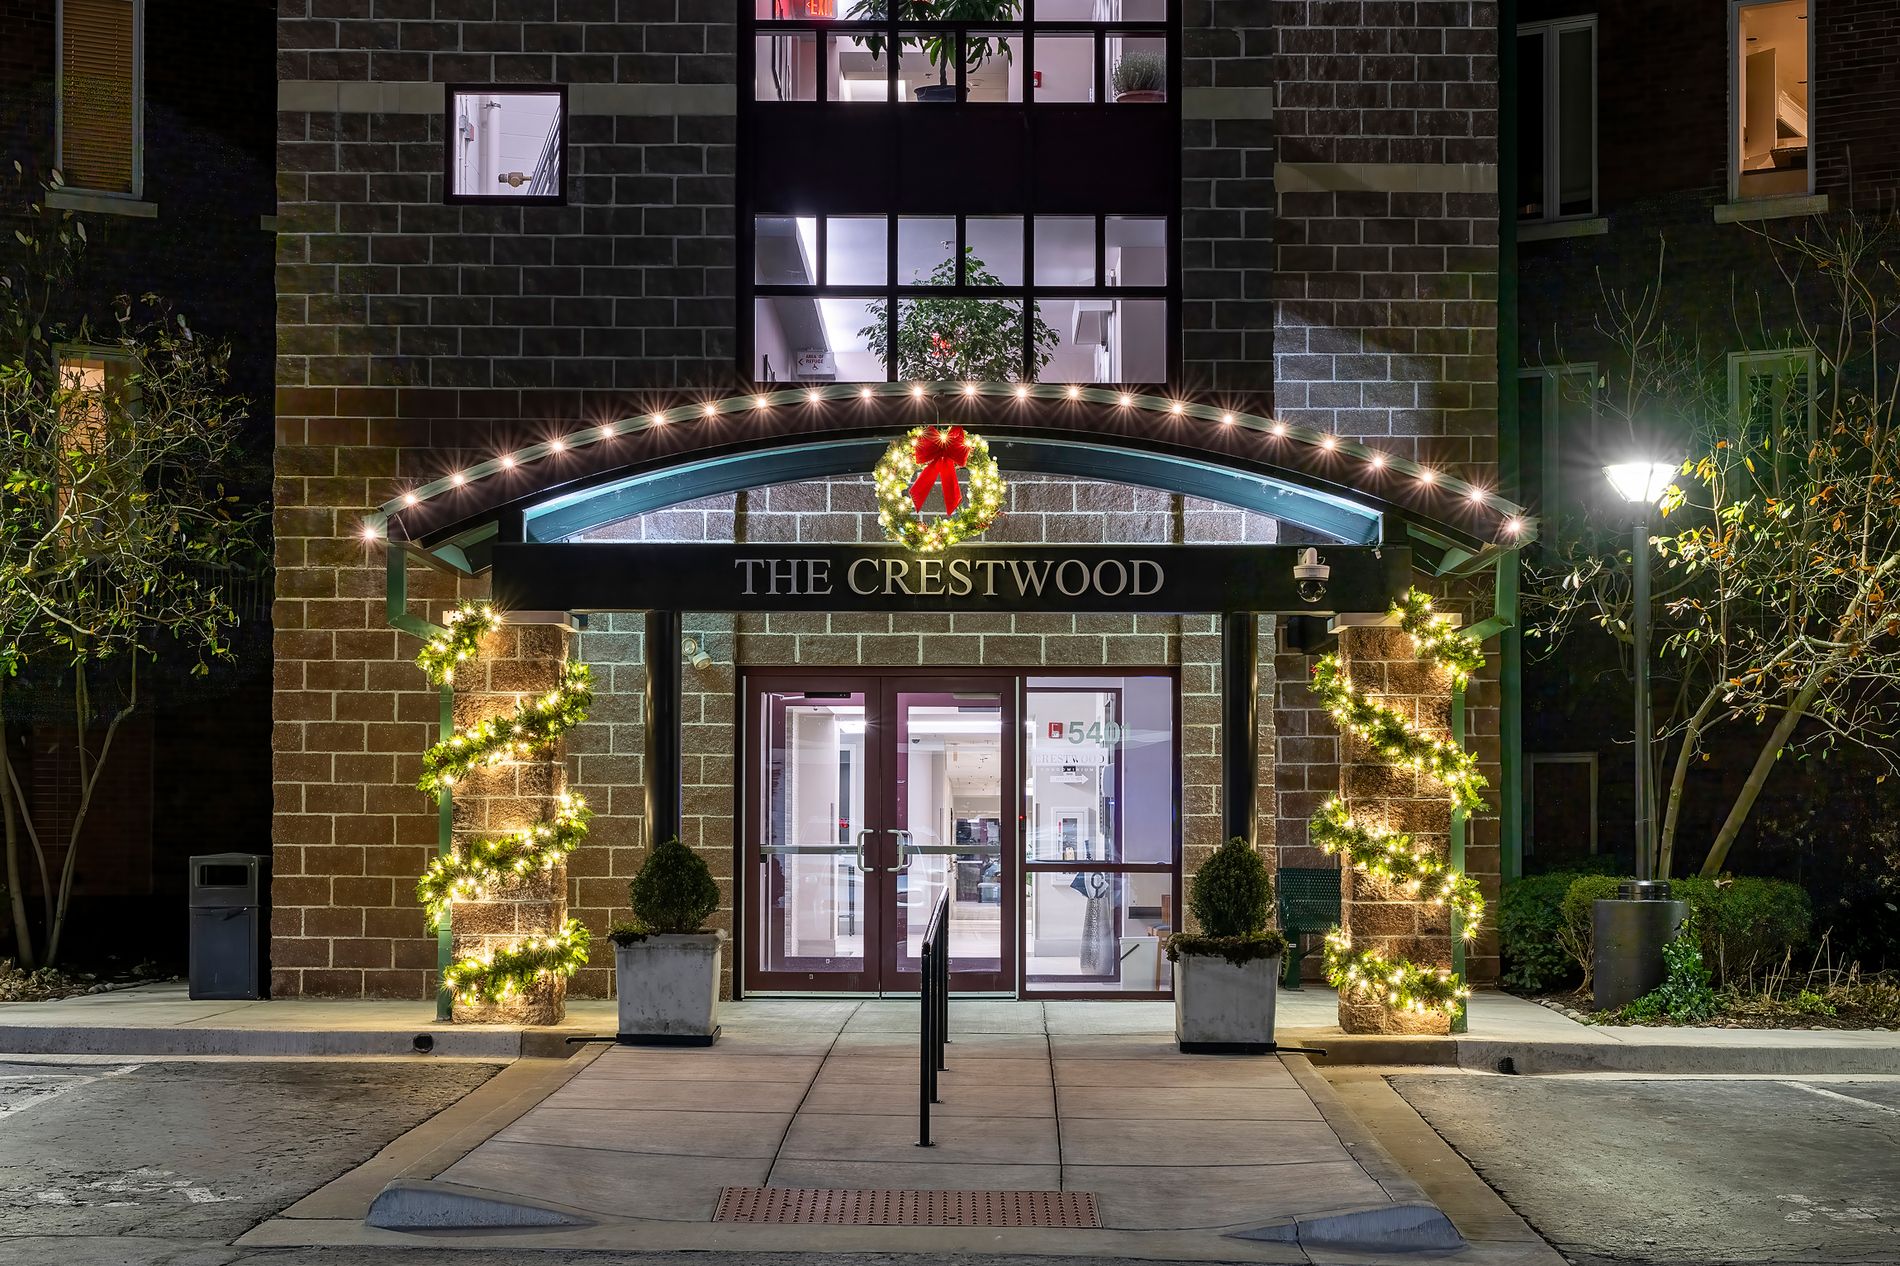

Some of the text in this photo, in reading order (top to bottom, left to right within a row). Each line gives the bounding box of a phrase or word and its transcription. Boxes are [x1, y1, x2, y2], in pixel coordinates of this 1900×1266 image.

[810, 0, 832, 16] EXIT
[734, 557, 1165, 597] THE CRESTWOOD
[1068, 721, 1133, 745] 5401
